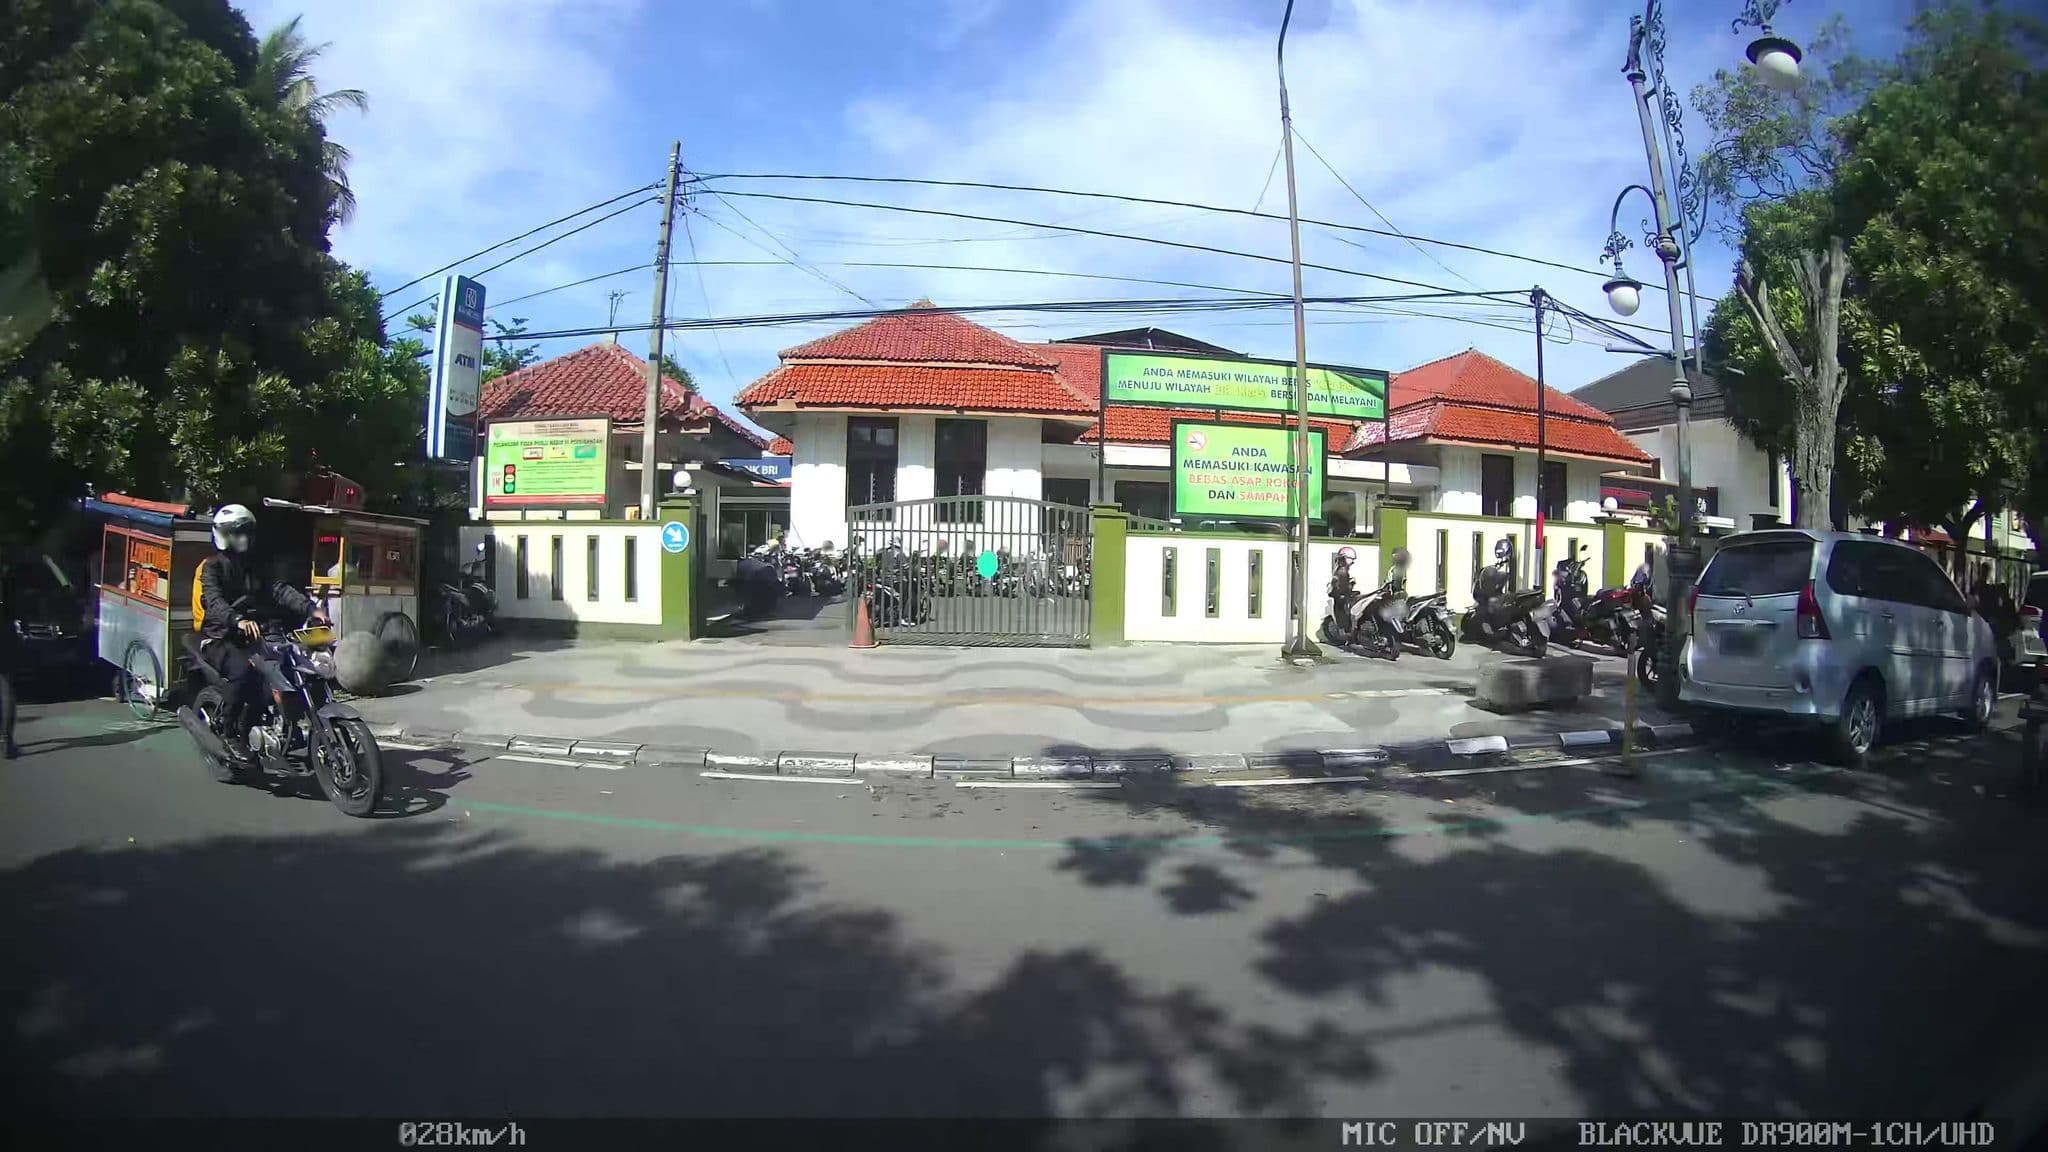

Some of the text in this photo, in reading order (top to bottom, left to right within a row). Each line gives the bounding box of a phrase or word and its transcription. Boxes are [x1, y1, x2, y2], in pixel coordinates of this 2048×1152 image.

[454, 353, 475, 369] ATM
[1143, 367, 1174, 377] ANDA
[1176, 369, 1231, 381] MEMASUKI
[1234, 373, 1279, 385] WILAYAH
[1118, 380, 1162, 390] MENUJU
[1165, 382, 1211, 393] WILAYAH
[1307, 393, 1328, 403] DAN
[1331, 396, 1377, 408] MELAYANI
[1231, 447, 1267, 458] ANDA
[762, 465, 778, 475] BRI
[1183, 459, 1249, 471] MEMASUKI
[1188, 474, 1227, 485] BEBAS
[1230, 476, 1261, 487] ASAP
[1208, 490, 1288, 503] DAN SAMPAH
